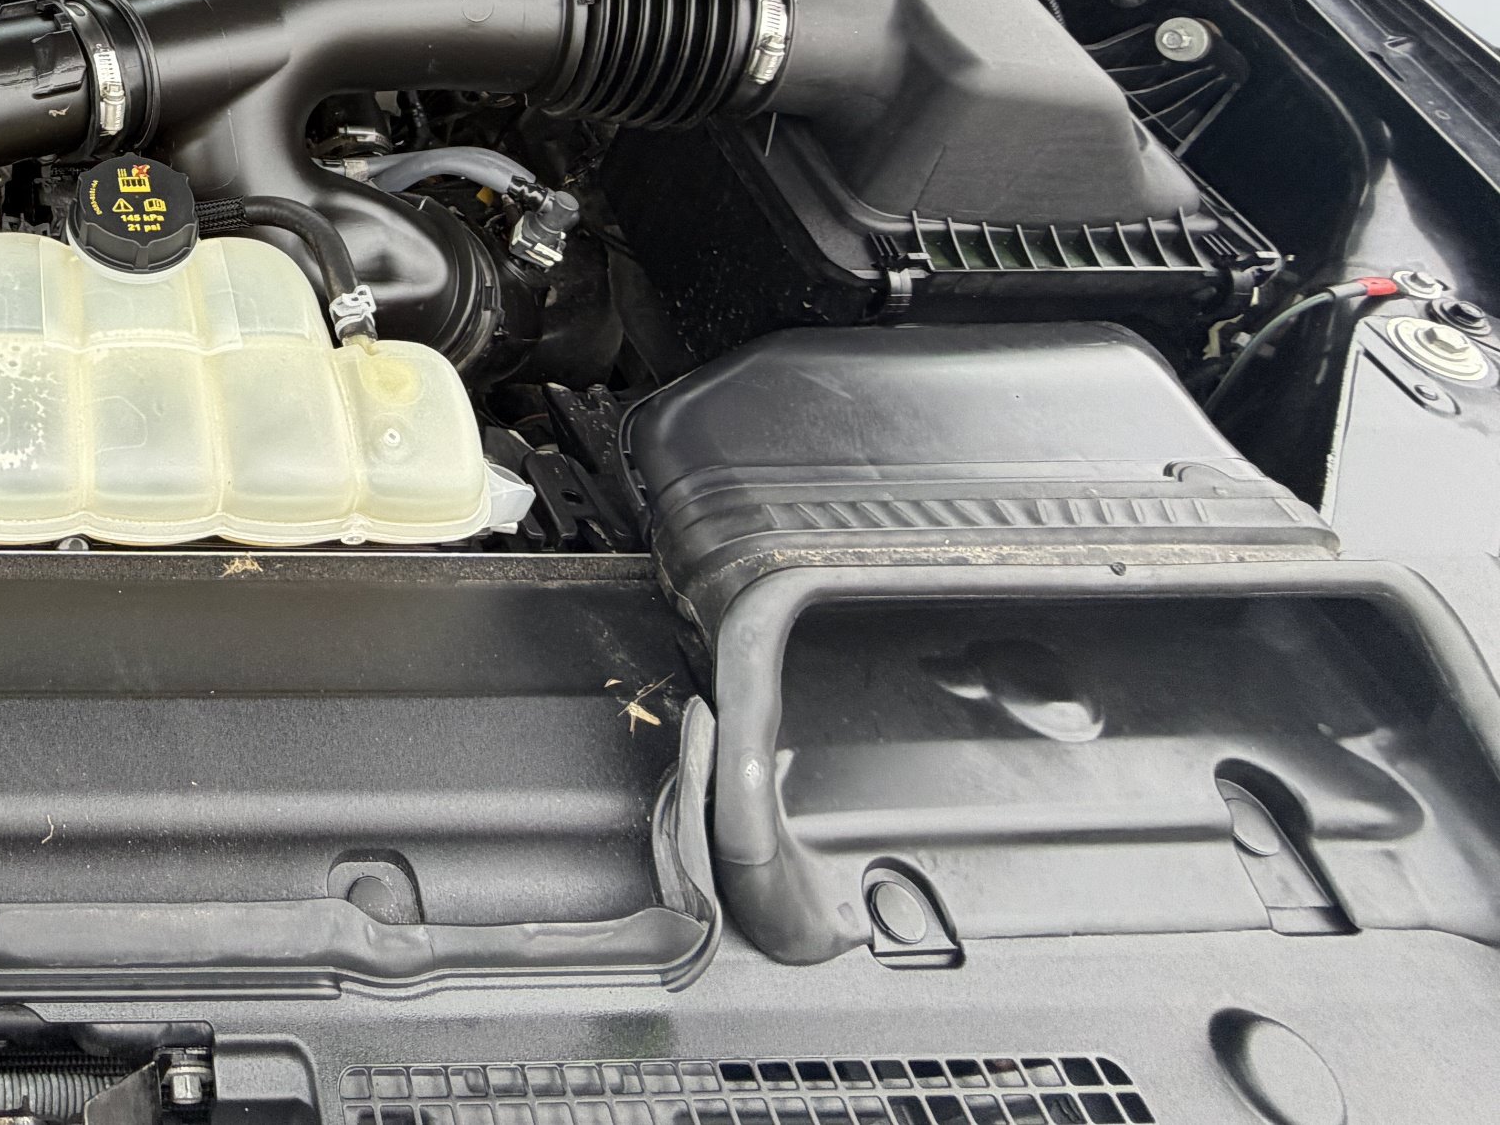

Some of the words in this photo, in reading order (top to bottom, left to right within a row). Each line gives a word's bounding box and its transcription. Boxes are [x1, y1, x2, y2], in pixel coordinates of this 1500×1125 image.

[120, 214, 141, 222] 145
[143, 214, 165, 222] kPa
[144, 223, 161, 233] psi
